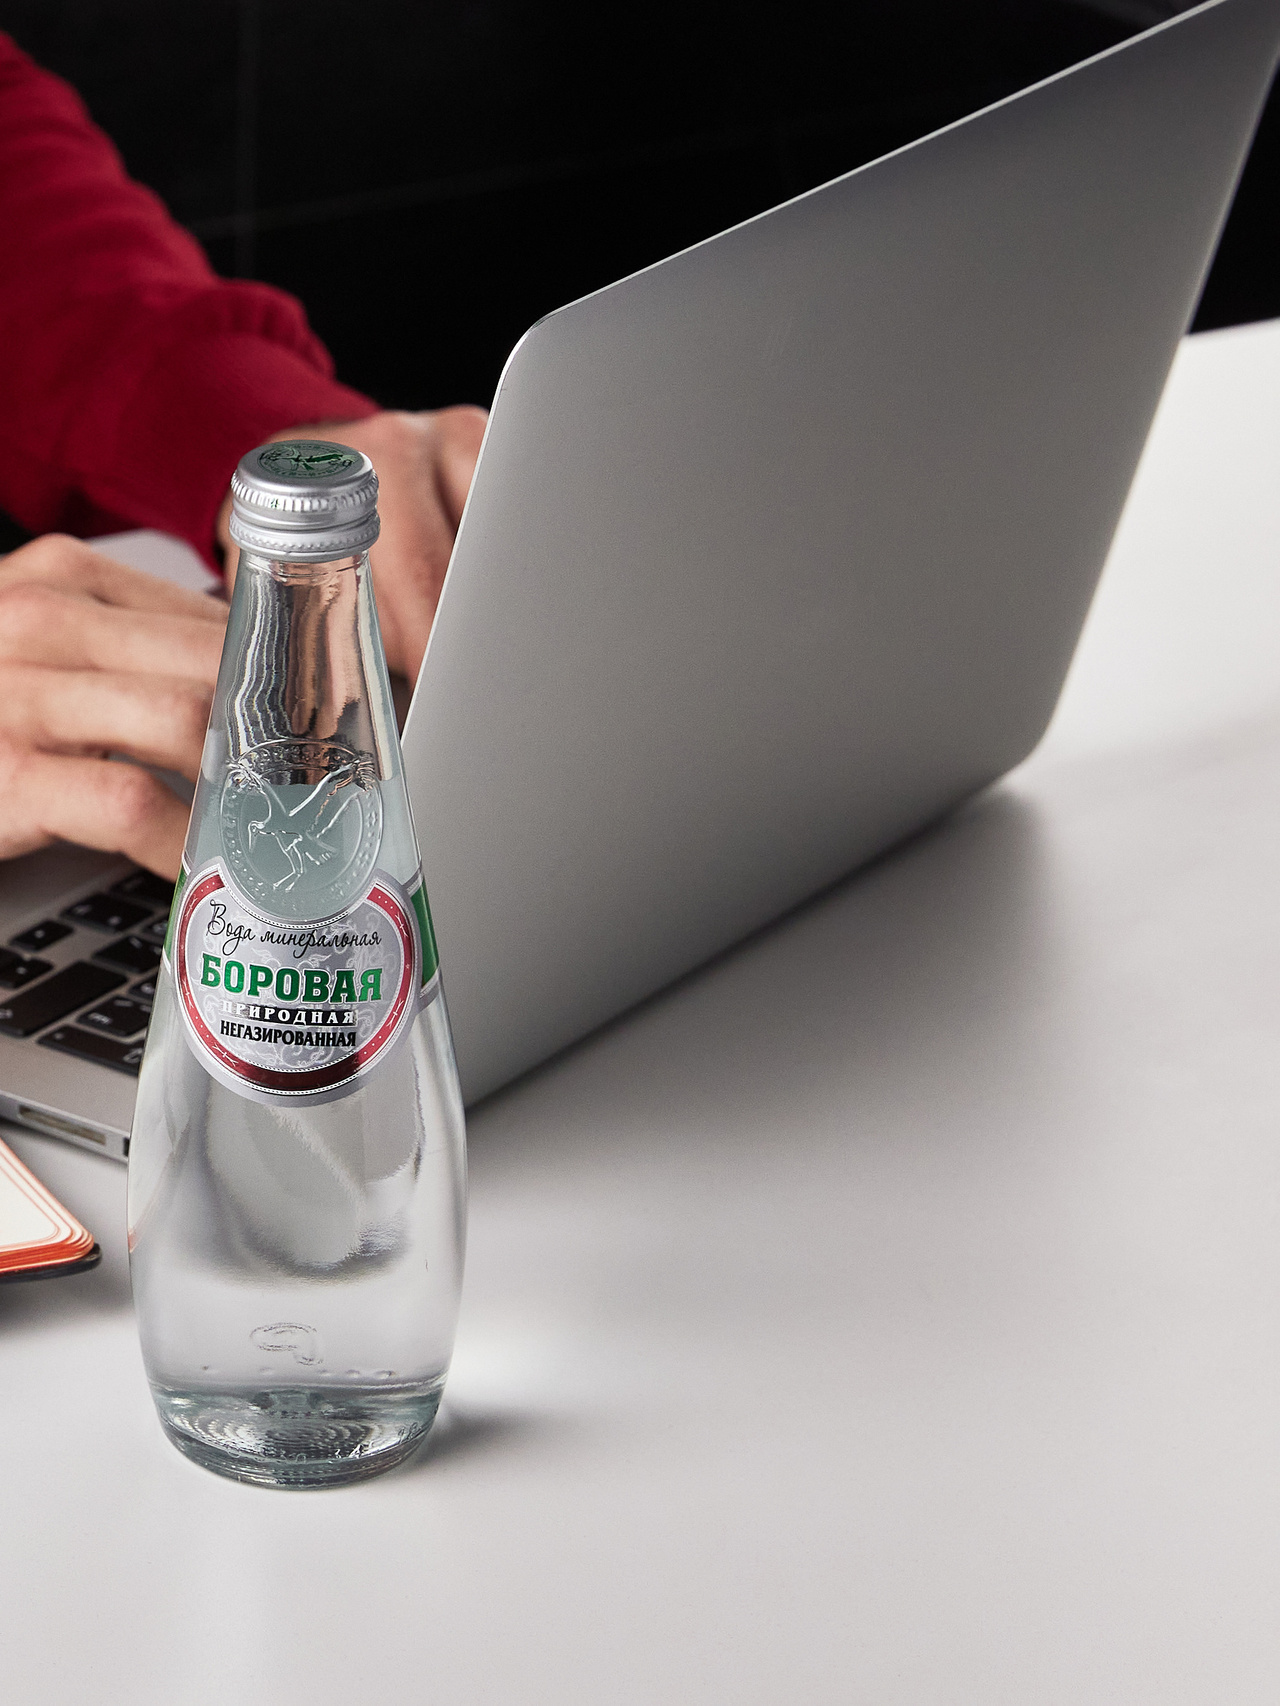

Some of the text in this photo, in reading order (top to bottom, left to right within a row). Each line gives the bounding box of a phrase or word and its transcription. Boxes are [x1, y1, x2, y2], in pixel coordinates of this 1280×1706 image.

[206, 899, 382, 958] Вода минеральная
[200, 952, 383, 1003] БОРОВАЯ
[221, 1000, 356, 1026] ПРИРОДНАЯ
[220, 1020, 357, 1047] НЕГАЗИРОВАННАЯ
